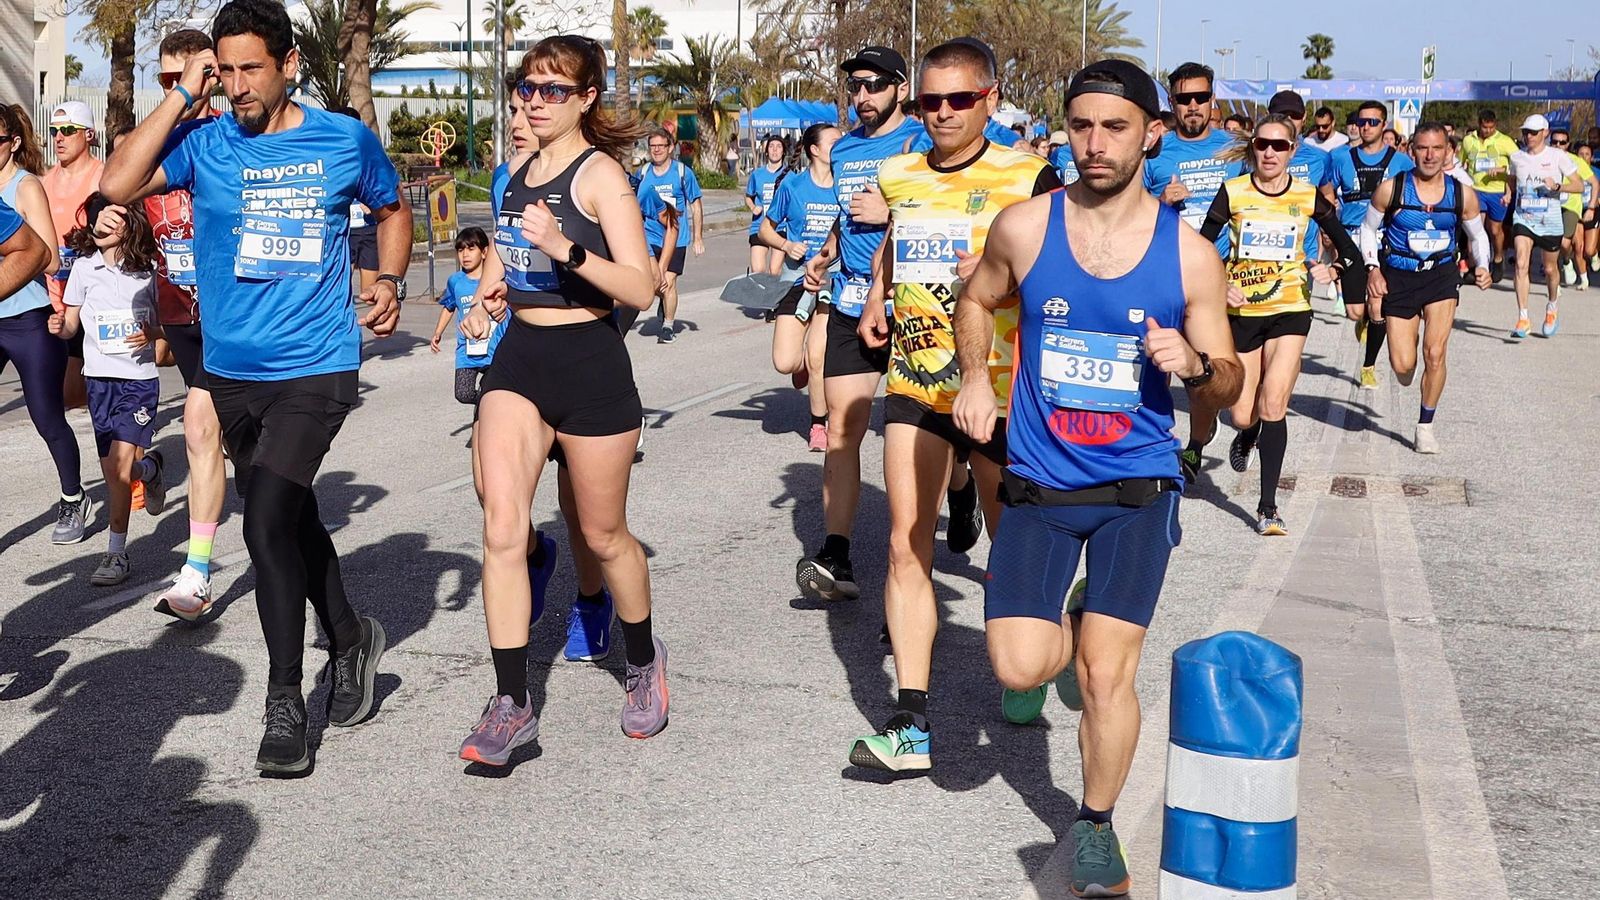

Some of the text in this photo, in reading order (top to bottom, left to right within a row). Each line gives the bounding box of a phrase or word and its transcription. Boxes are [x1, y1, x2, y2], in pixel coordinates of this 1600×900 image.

[1384, 84, 1430, 95] mayoral
[243, 160, 323, 182] mayoral
[242, 187, 323, 200] RUNNING
[250, 198, 317, 210] MAKES
[262, 237, 301, 257] 999
[1251, 233, 1286, 247] 2255
[1424, 241, 1437, 249] 47
[906, 240, 955, 259] 2934
[507, 247, 531, 267] 286
[1232, 266, 1276, 281] BONELA
[1241, 276, 1267, 287] BIKE
[1058, 342, 1089, 352] Solidaria
[1060, 335, 1085, 345] Carrera
[1064, 356, 1114, 383] 339
[1054, 411, 1128, 437] TROPS
